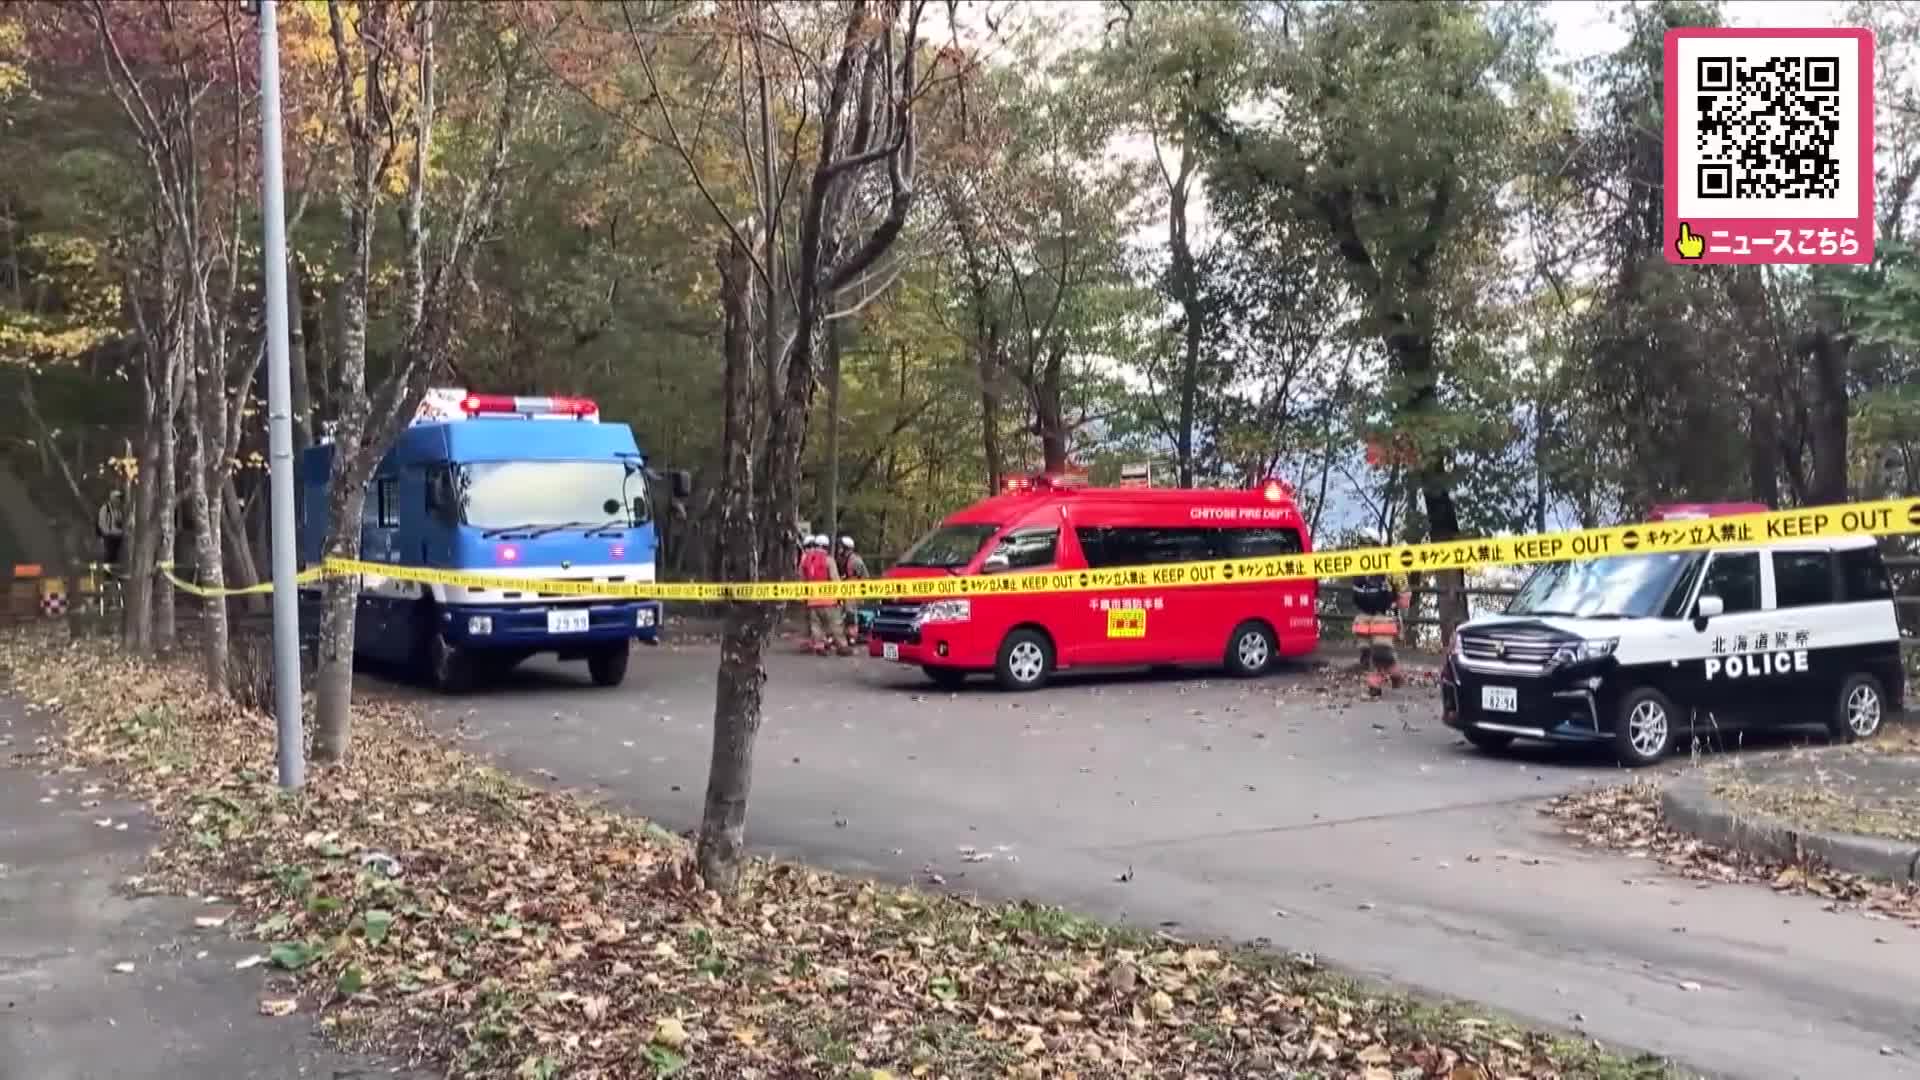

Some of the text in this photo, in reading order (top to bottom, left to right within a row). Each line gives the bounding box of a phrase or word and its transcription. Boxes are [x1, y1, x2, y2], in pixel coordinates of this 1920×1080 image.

[1190, 507, 1292, 520] CHITOSE FIRE DEPT.
[1767, 509, 1892, 537] KEEP OUT
[1514, 535, 1610, 559] KEEP OUT
[1314, 552, 1391, 573] KEEP OUT
[1022, 574, 1073, 589] KEEP OUT
[1153, 565, 1216, 583] KEEP OUT
[818, 583, 856, 594] KEEP OUT
[912, 581, 956, 593] KEEP OUT
[1712, 630, 1810, 654] 北海道警察
[1705, 650, 1809, 680] POLICE
